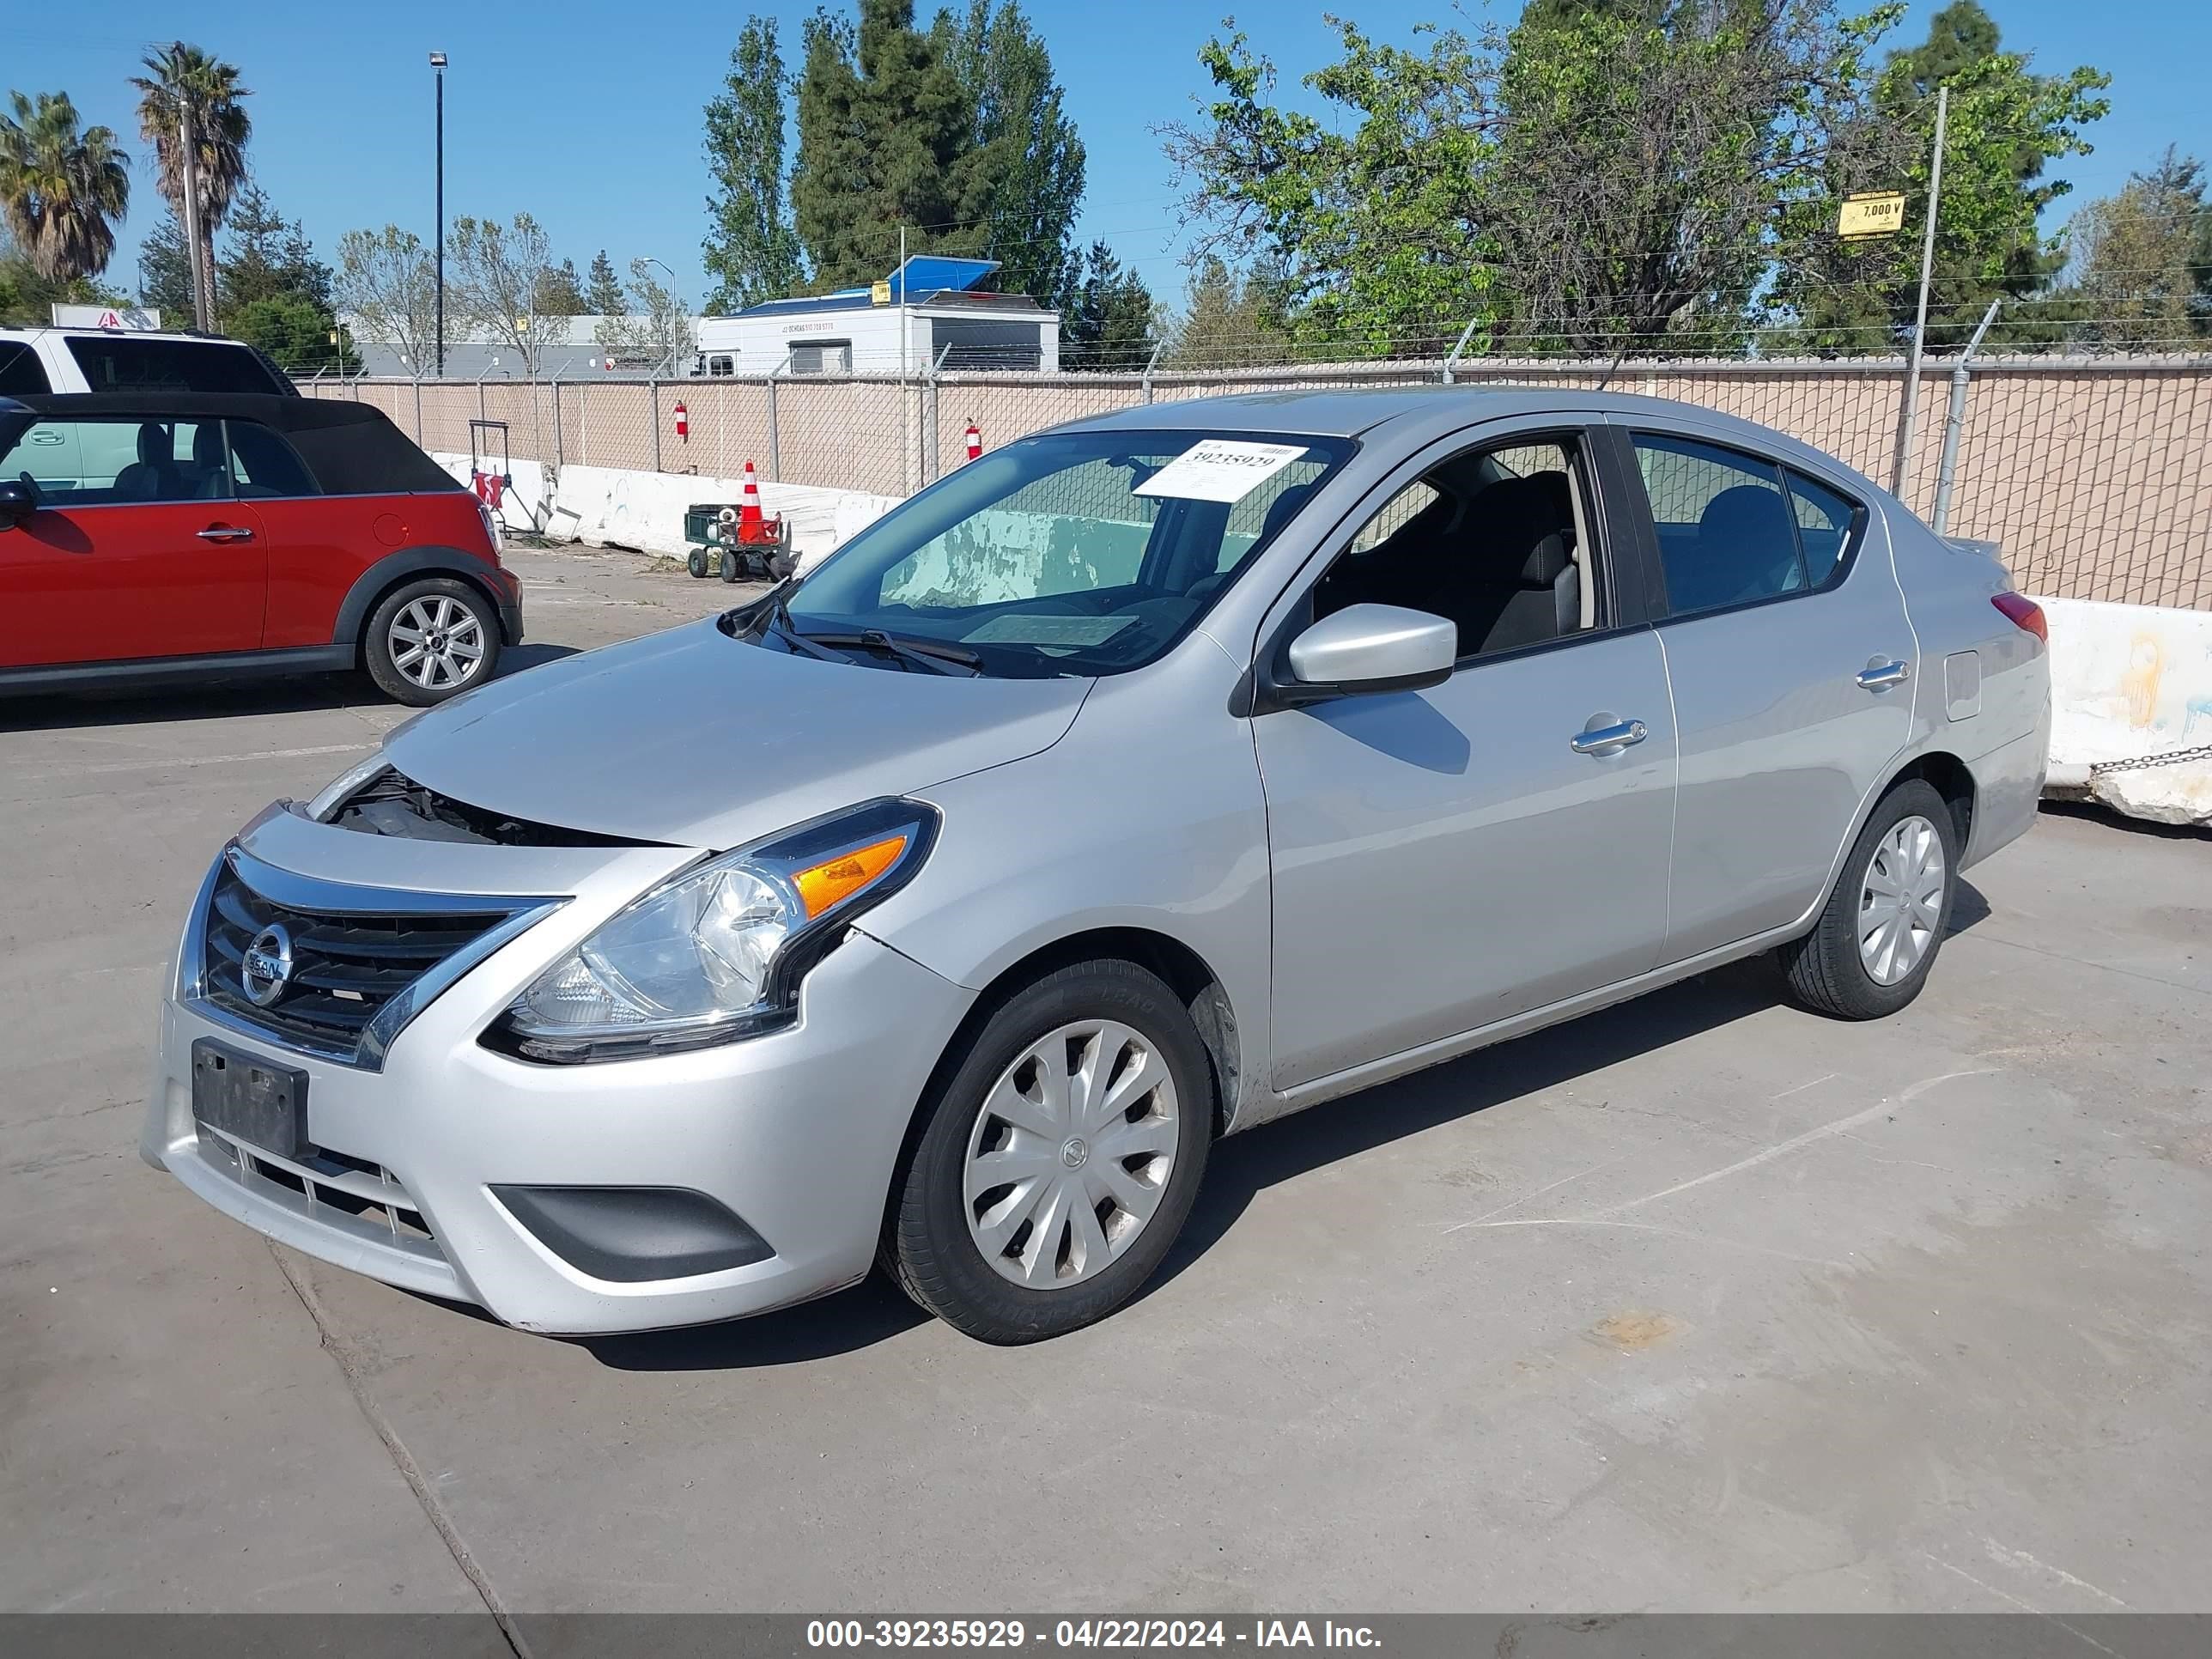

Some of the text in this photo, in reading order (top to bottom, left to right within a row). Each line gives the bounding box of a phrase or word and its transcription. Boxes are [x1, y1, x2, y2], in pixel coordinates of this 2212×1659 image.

[1863, 203, 1901, 218] 7,000 V
[1185, 452, 1276, 468] 39235929
